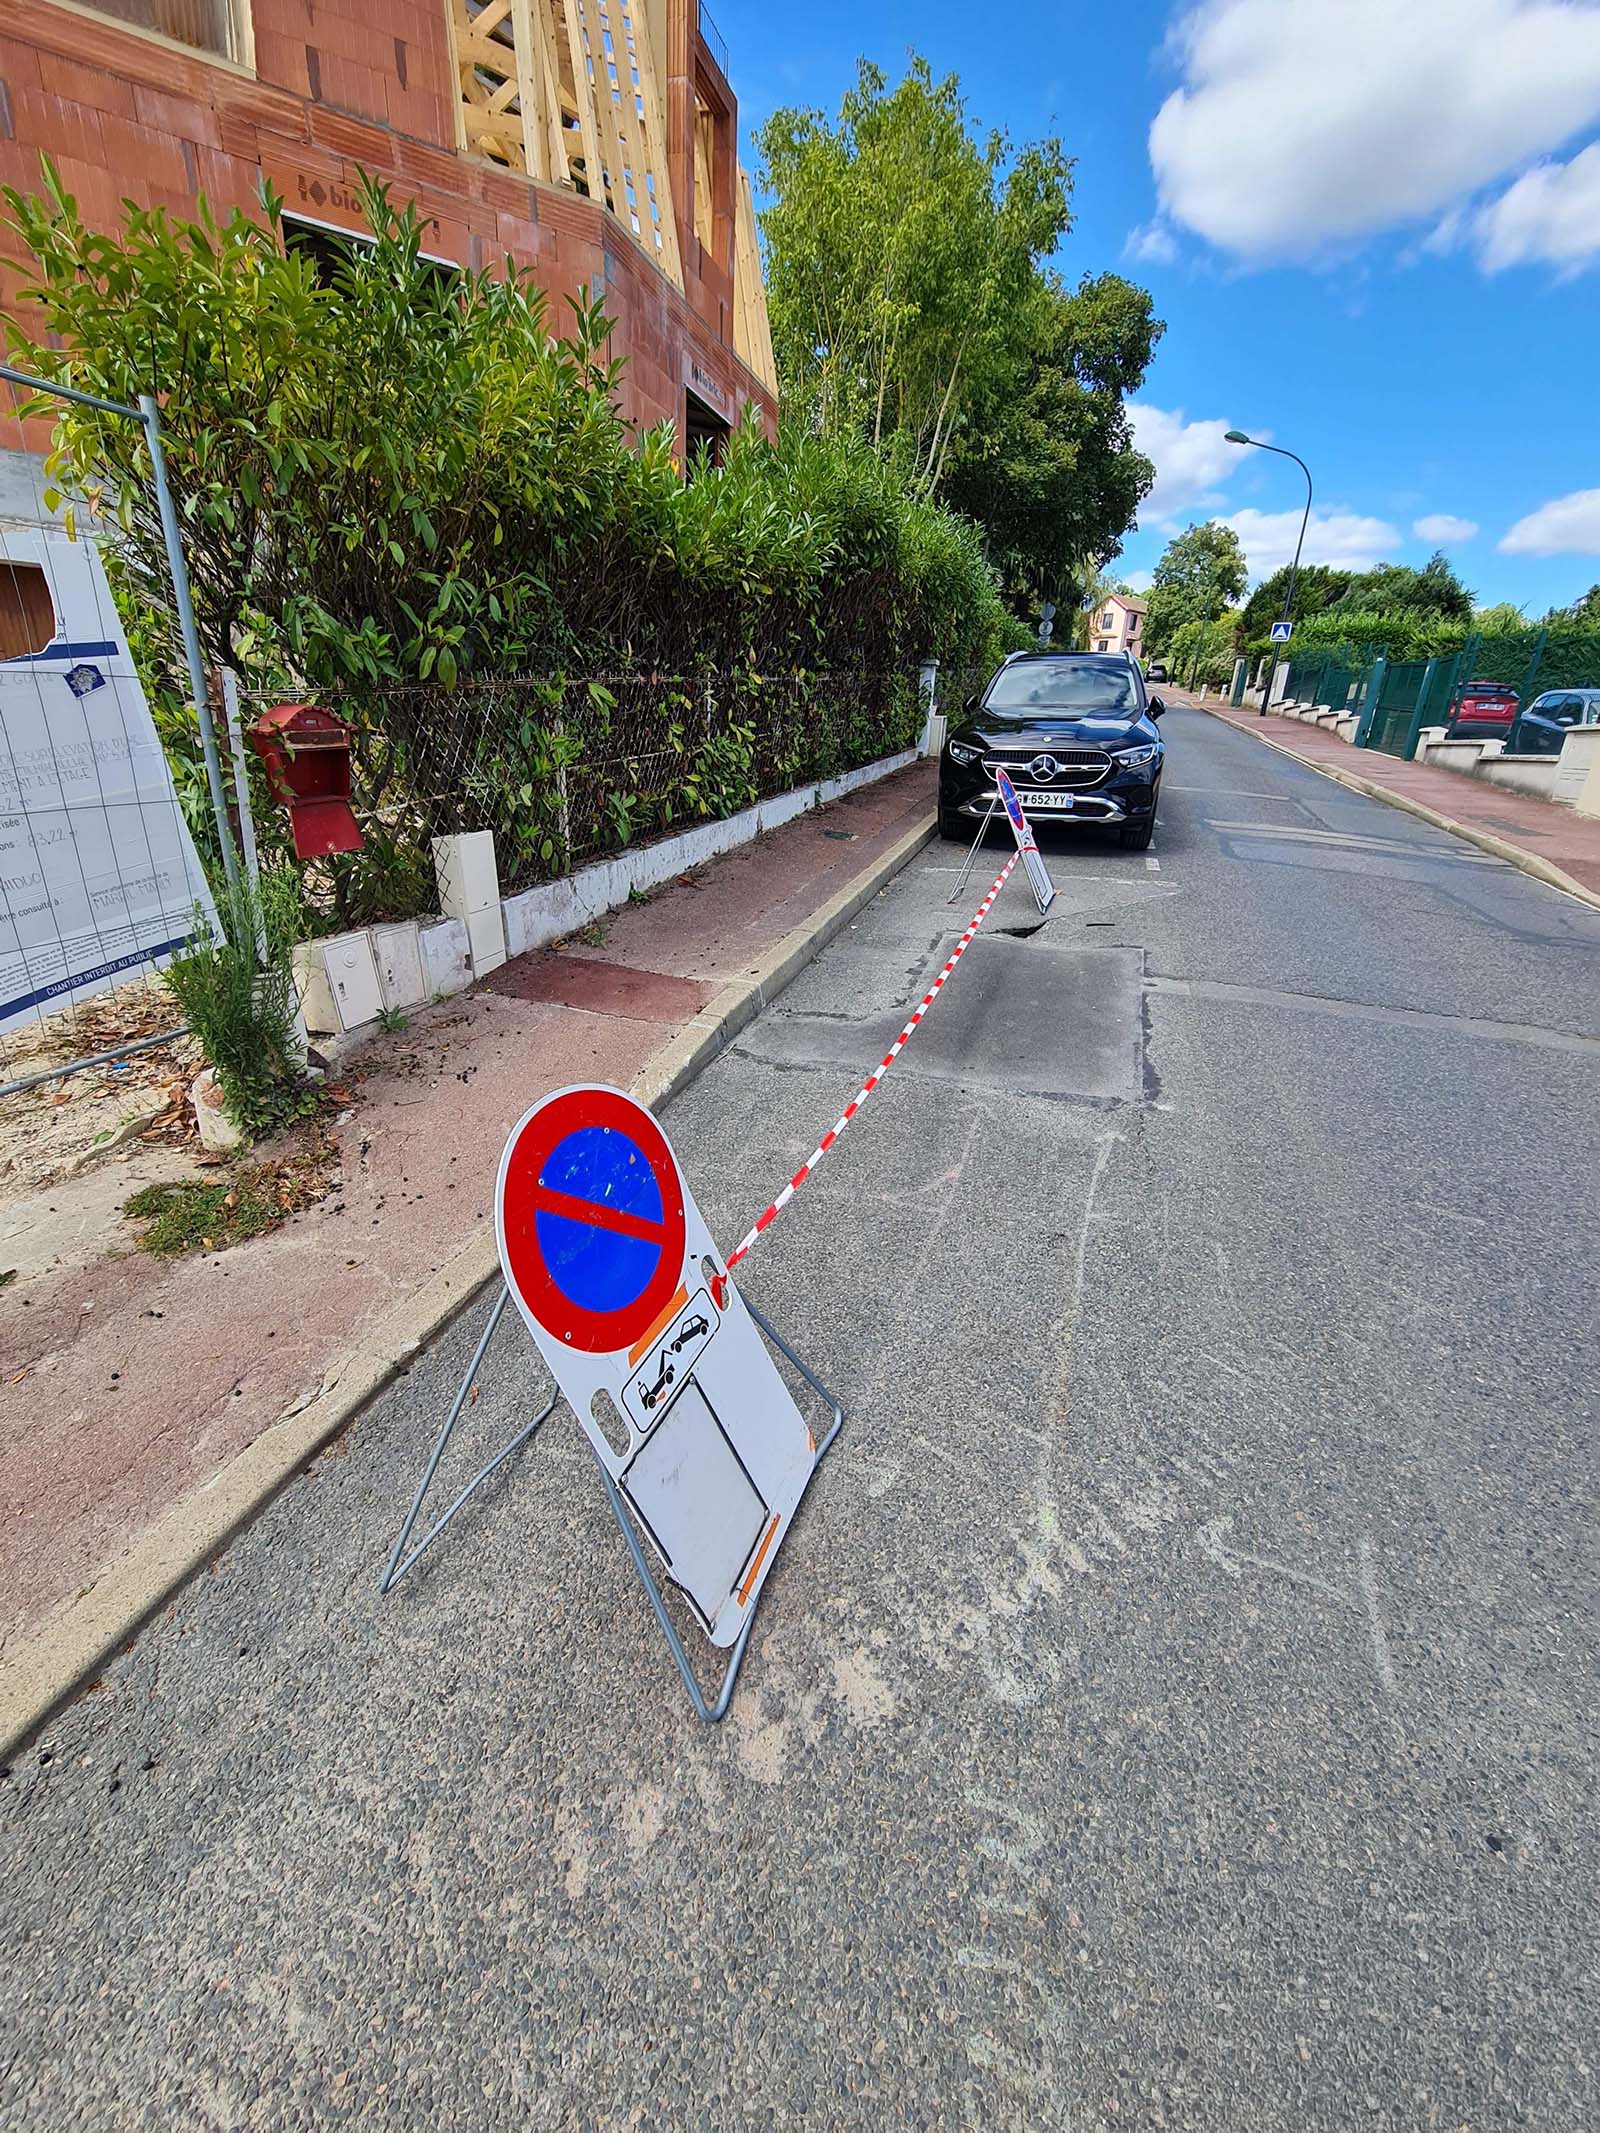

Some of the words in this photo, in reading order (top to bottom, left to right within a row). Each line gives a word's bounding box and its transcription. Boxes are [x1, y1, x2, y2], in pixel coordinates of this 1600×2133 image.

[46, 976, 83, 996] CHANTIER
[84, 962, 117, 981] INTERDIT
[118, 959, 128, 970] AU
[129, 949, 154, 964] PUBLIC
